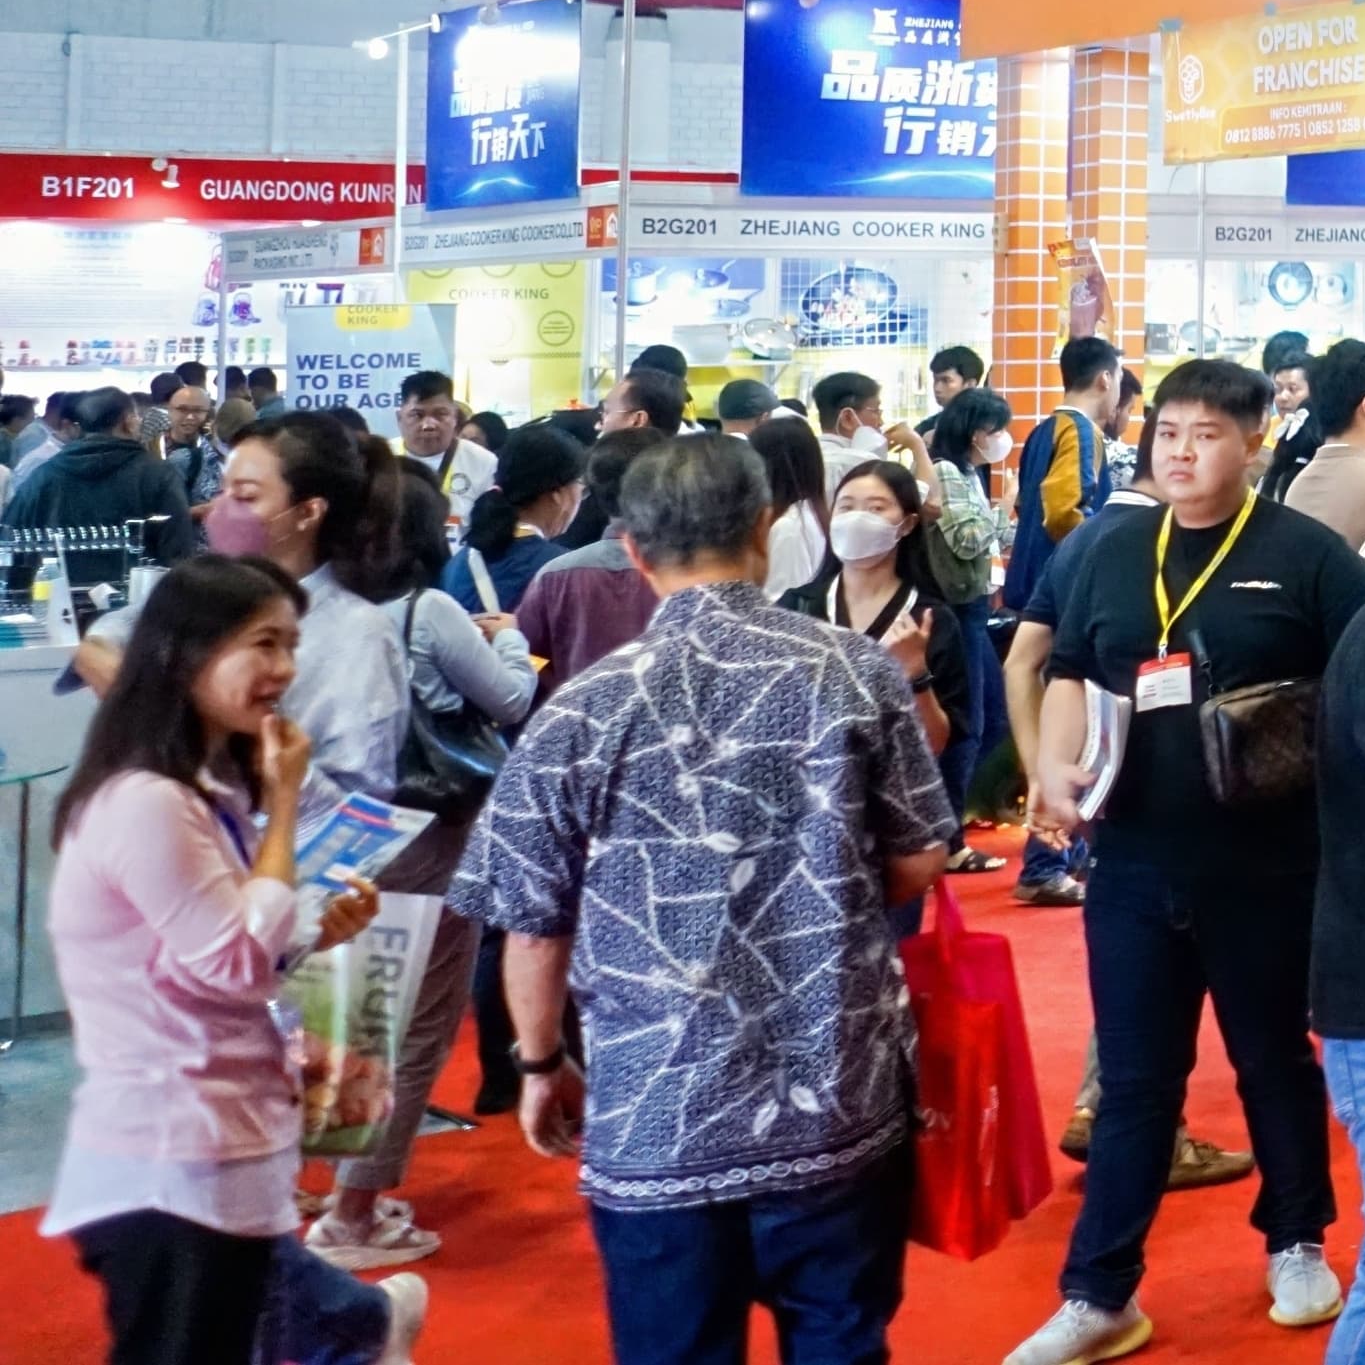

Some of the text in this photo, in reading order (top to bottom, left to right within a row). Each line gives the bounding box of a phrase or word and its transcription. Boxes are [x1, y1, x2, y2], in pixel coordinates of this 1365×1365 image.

[1258, 16, 1358, 54] OPEN FOR
[41, 176, 134, 198] B1F201
[200, 179, 422, 204] GUANGDONG KUNRN
[641, 218, 986, 238] B2G201 ZHEJIANG COOKER KING
[1215, 227, 1272, 241] B2G201
[514, 288, 550, 300] KING
[347, 315, 378, 325] KING
[296, 353, 421, 370] WELCOME
[296, 373, 370, 390] TO BE
[295, 393, 349, 409] OUR
